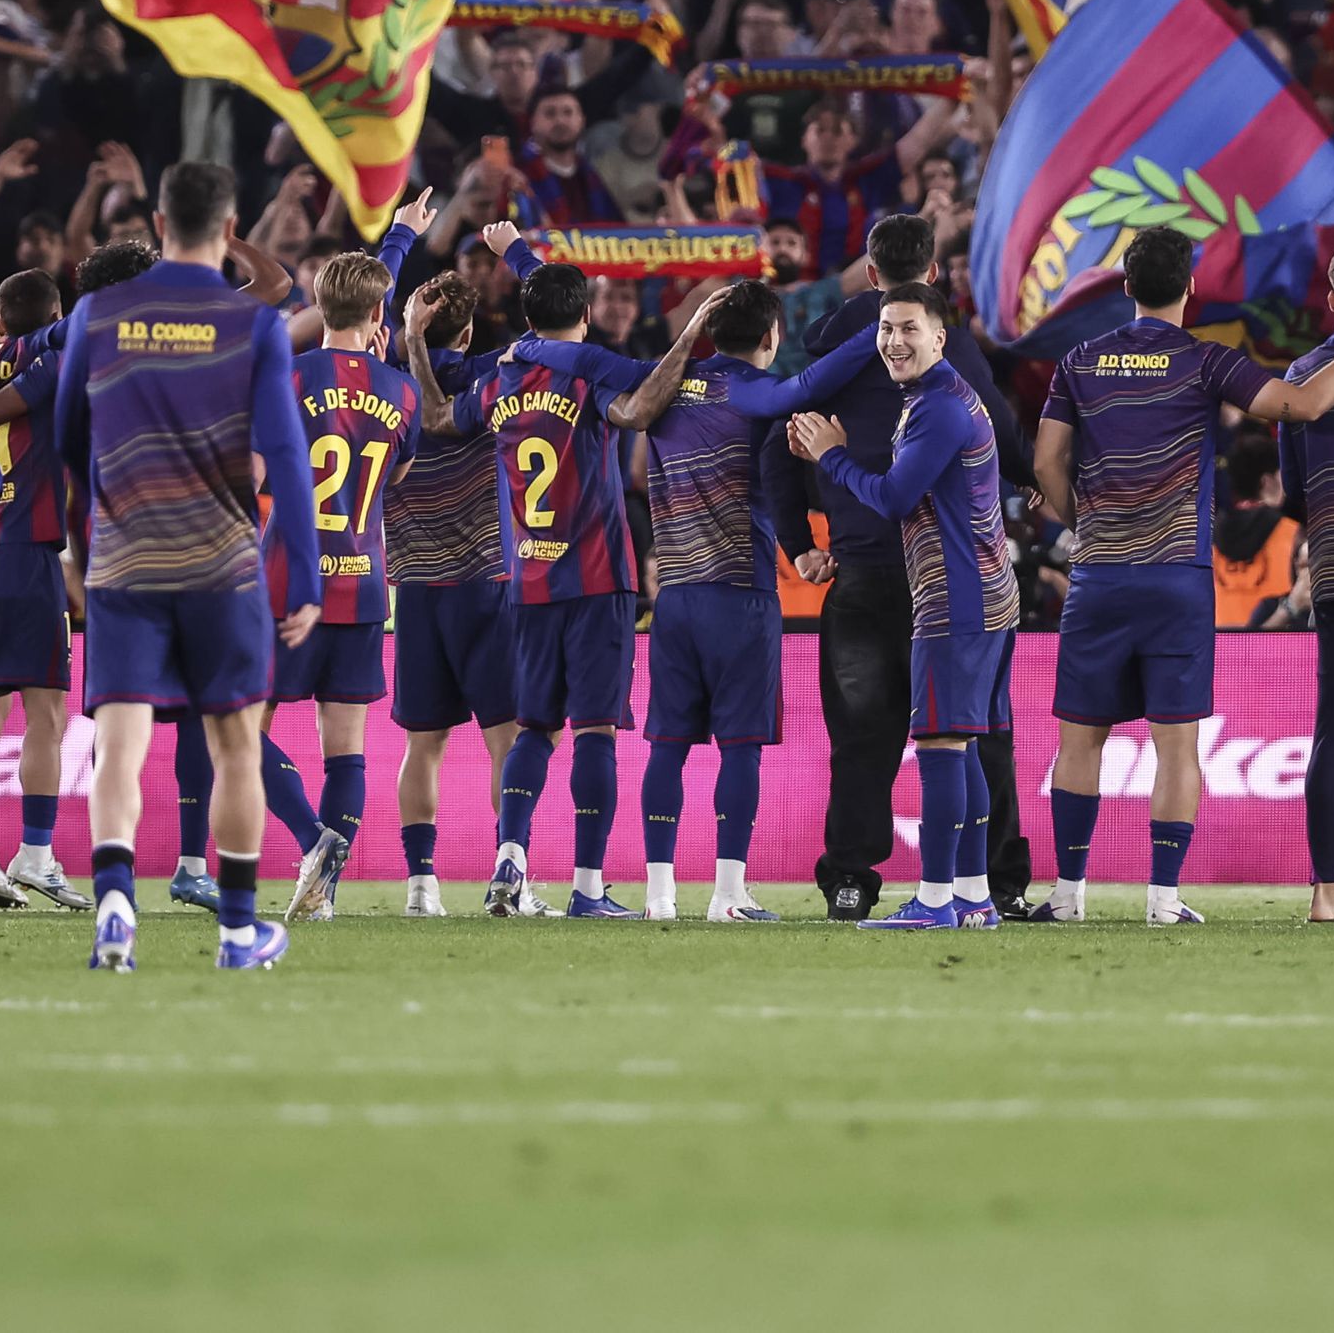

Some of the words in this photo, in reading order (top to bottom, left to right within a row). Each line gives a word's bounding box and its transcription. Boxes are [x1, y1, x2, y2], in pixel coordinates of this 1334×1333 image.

[152, 322, 217, 342] CONGO
[1121, 354, 1170, 369] CONGO
[303, 395, 325, 418] F.
[323, 387, 349, 410] DE
[350, 389, 402, 431] JONG
[490, 394, 520, 434] JOÃO
[309, 434, 390, 535] 21
[517, 436, 559, 528] 2
[534, 539, 569, 551] UNHCR
